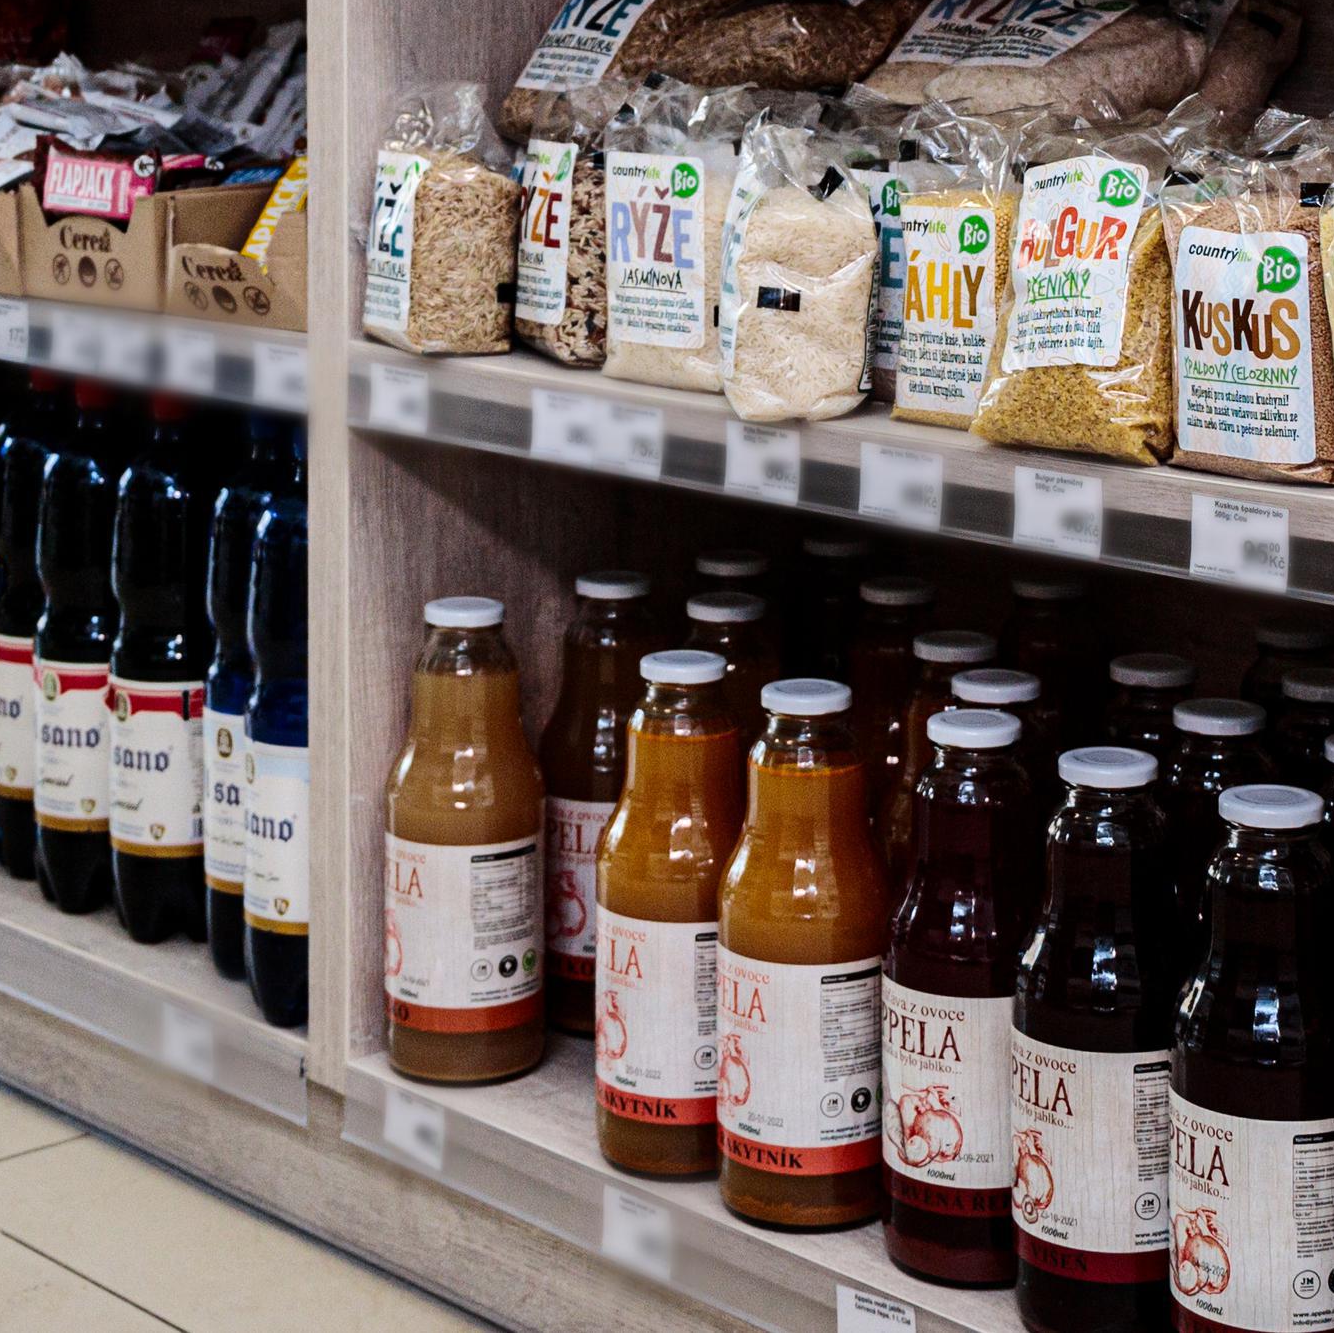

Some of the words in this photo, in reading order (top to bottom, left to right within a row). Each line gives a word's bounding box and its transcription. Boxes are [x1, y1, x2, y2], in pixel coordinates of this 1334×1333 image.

[51, 161, 115, 199] FLAPJACK
[672, 168, 697, 194] Bio
[1107, 172, 1136, 199] Bio
[611, 185, 694, 269] RÝŽE
[964, 220, 988, 247] Bio
[1018, 206, 1128, 269] BULGUR
[621, 267, 683, 290] JASMÍNOVÁ
[1261, 254, 1297, 287] Bio
[905, 248, 986, 329] ÁHLY
[1182, 289, 1301, 361] KUSKUS
[1231, 364, 1298, 386] CELOZRNNÝ
[1255, 393, 1289, 409] kuchyni!
[1264, 425, 1300, 442] zeleniny.
[1269, 554, 1286, 570] Kč
[920, 1005, 966, 1023] ovoce
[1034, 1053, 1077, 1075] ovoce
[599, 1088, 678, 1121] AKYTNÍK
[1190, 1119, 1235, 1143] ovoce
[927, 1169, 956, 1182] 1000ml
[1041, 1224, 1070, 1241] 1000ml
[1195, 1298, 1225, 1317] 1000ml
